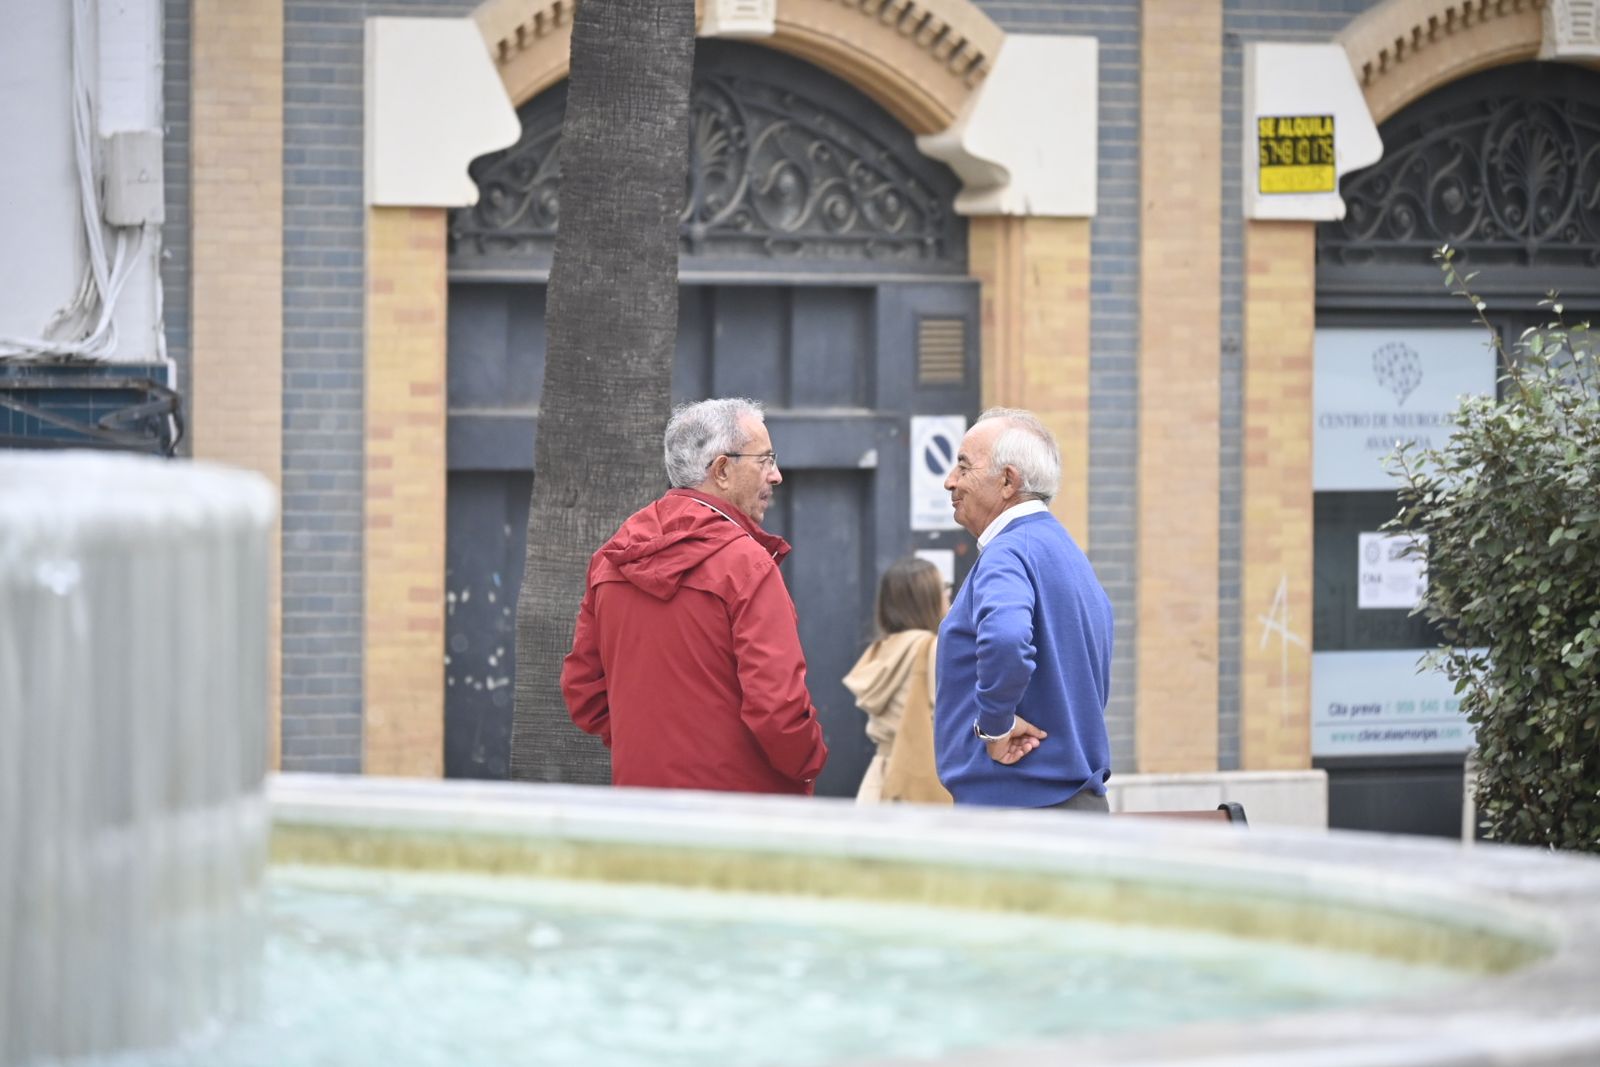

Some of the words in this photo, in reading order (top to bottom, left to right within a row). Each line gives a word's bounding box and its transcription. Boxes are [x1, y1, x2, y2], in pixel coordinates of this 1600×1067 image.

[1259, 117, 1276, 137] SE
[1279, 116, 1333, 136] ALQUILA
[1319, 412, 1370, 428] CENTRO
[1372, 412, 1387, 427] DE
